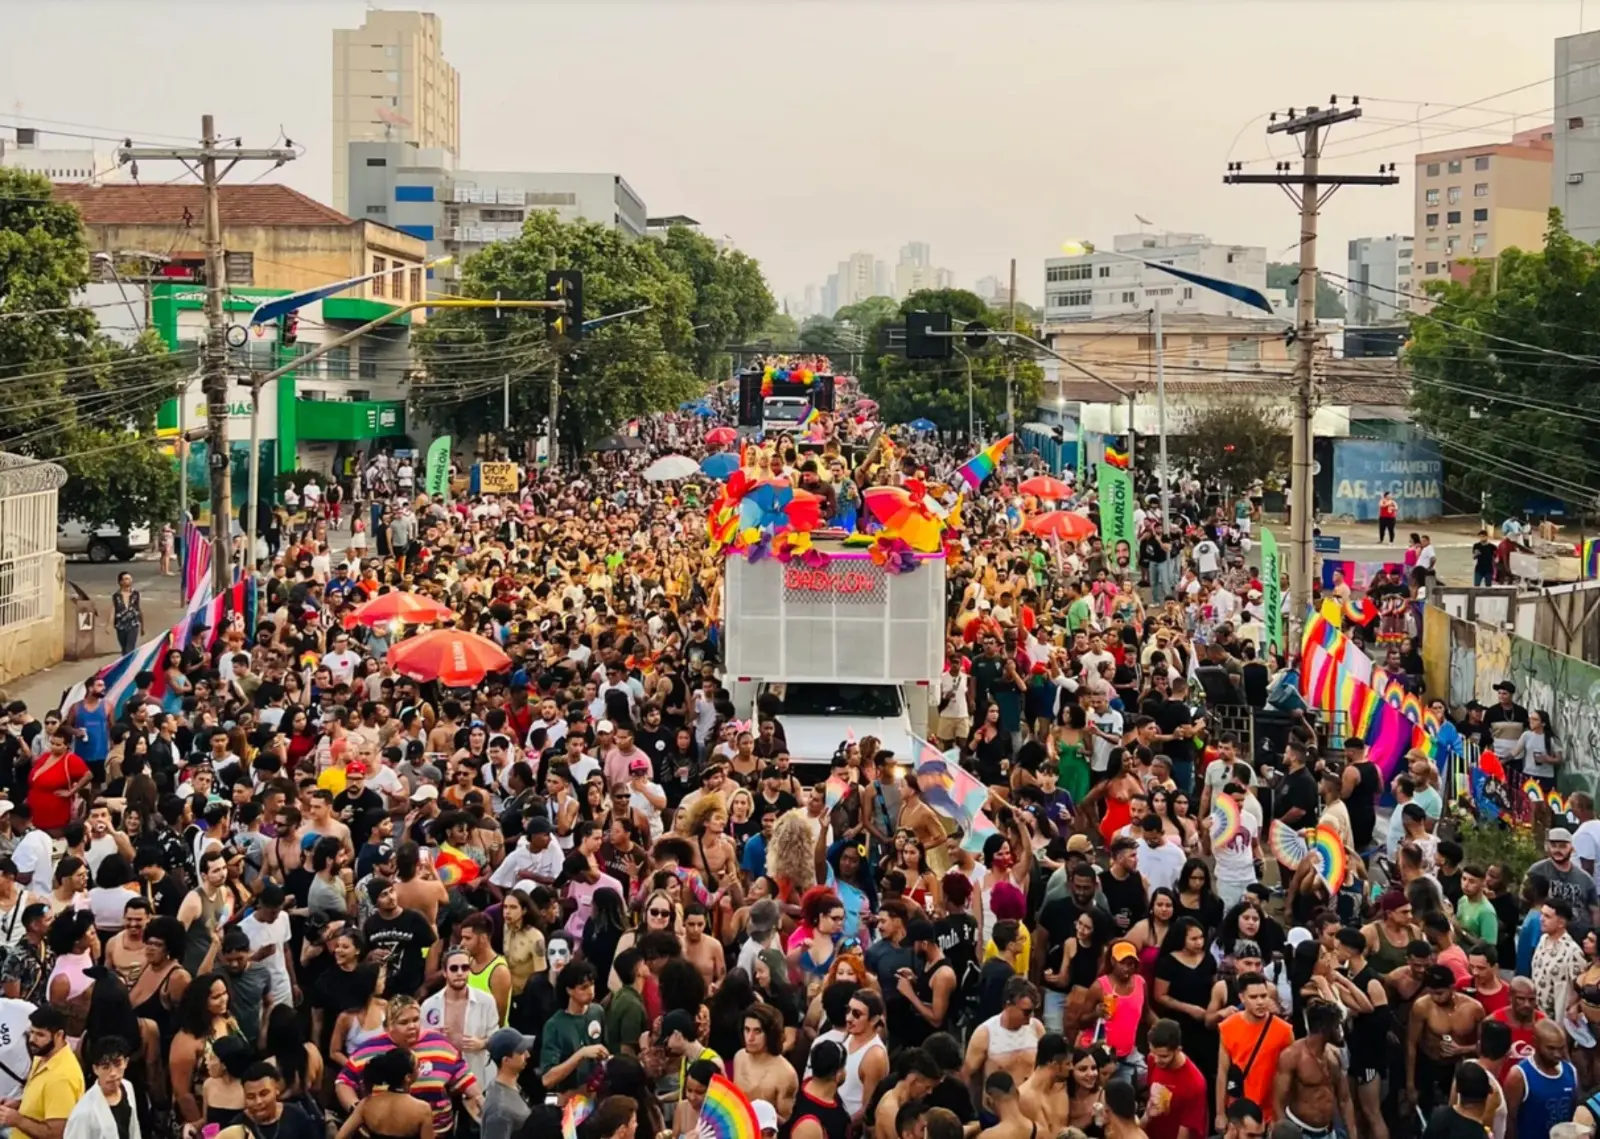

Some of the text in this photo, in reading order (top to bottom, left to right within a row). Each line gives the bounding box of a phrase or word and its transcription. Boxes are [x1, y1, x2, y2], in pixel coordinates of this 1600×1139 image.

[432, 448, 448, 491] MARLON
[482, 464, 511, 475] CHOPP
[1114, 479, 1126, 538] MARLON
[1268, 552, 1277, 636] MARLON
